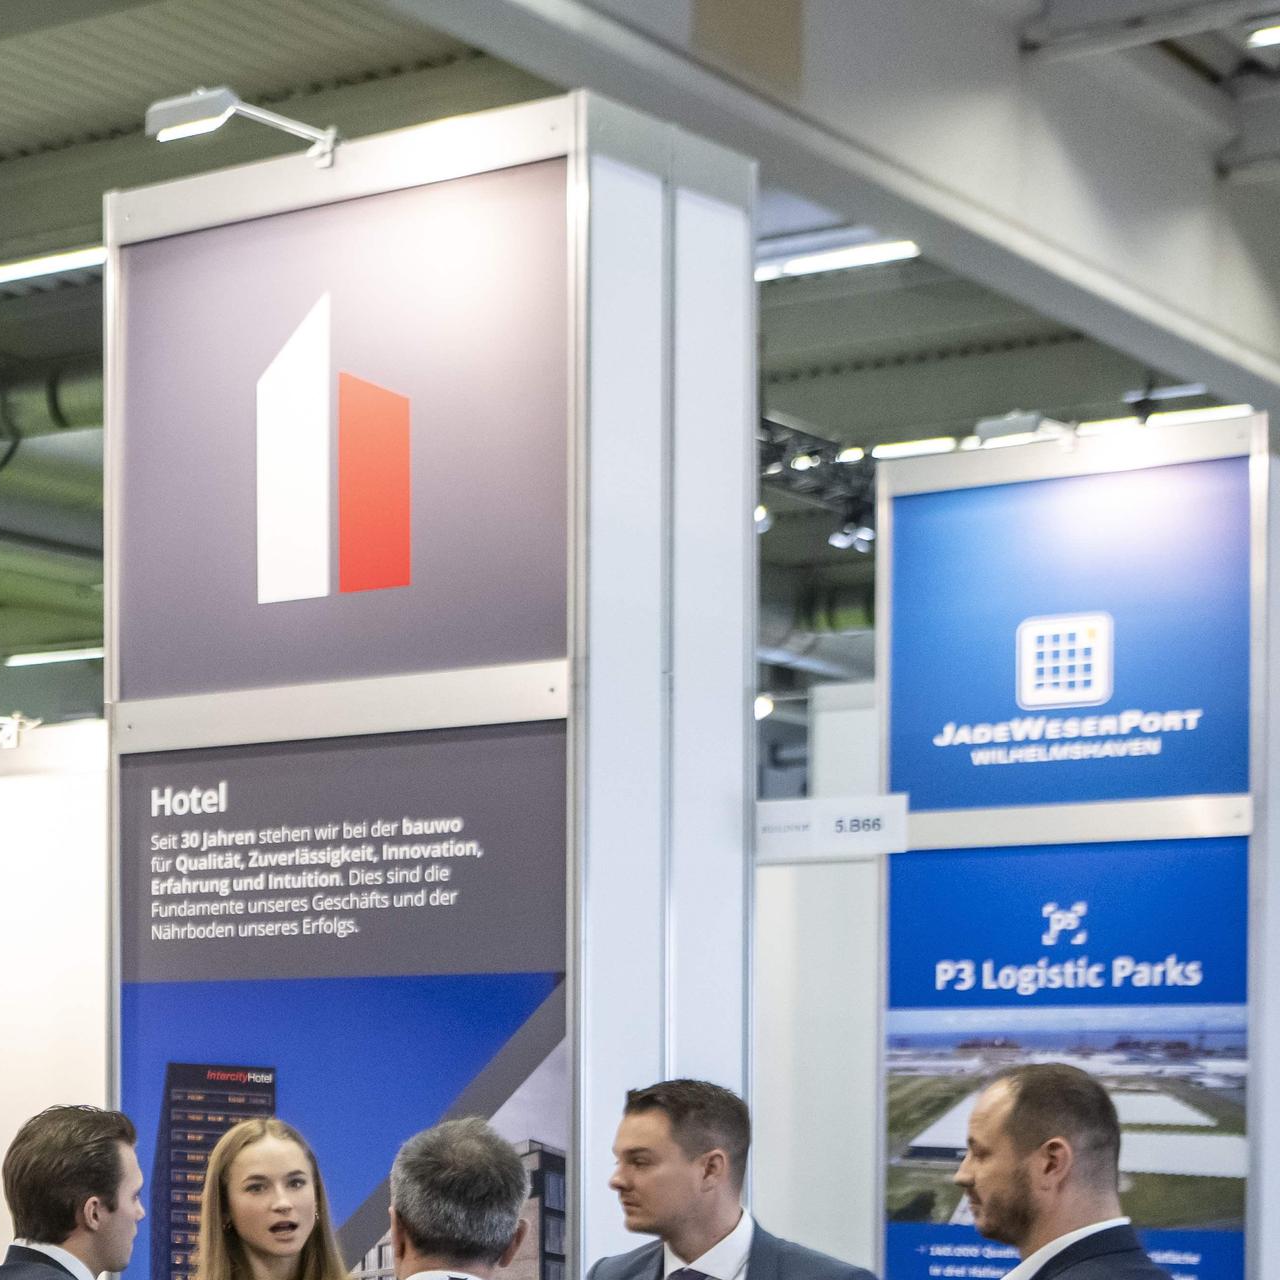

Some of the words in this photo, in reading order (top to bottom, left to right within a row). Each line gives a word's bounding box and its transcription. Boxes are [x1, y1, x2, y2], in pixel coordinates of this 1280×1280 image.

[151, 781, 227, 817] Hotel
[151, 835, 178, 850] Seit
[180, 832, 199, 849] 30
[201, 830, 256, 851] Jahren
[258, 826, 311, 845] stehen
[314, 824, 340, 840] wir
[342, 820, 367, 839] bei
[371, 820, 399, 837] der
[402, 816, 463, 836] bauwo
[835, 818, 882, 832] 5.B66
[151, 856, 172, 873] für
[175, 853, 245, 874] Qualität,
[248, 844, 379, 868] Zuverlässigkeit,
[382, 840, 484, 861] Innovation,
[151, 877, 230, 896] Erfahrung
[233, 873, 265, 891] und
[268, 870, 344, 890] Intuition.
[348, 869, 383, 886] Dies
[386, 865, 421, 884] sind
[424, 865, 451, 882] die
[151, 900, 244, 918] Fundamente
[248, 896, 309, 913] unseres
[312, 892, 389, 911] Geschäfts
[393, 888, 426, 908] und
[429, 888, 458, 906] der
[151, 922, 234, 941] Nährboden
[238, 920, 299, 938] unseres
[302, 916, 360, 938] Erfolgs.
[935, 959, 976, 991] P3
[982, 957, 1105, 995] Logistic
[1112, 953, 1203, 987] Parks
